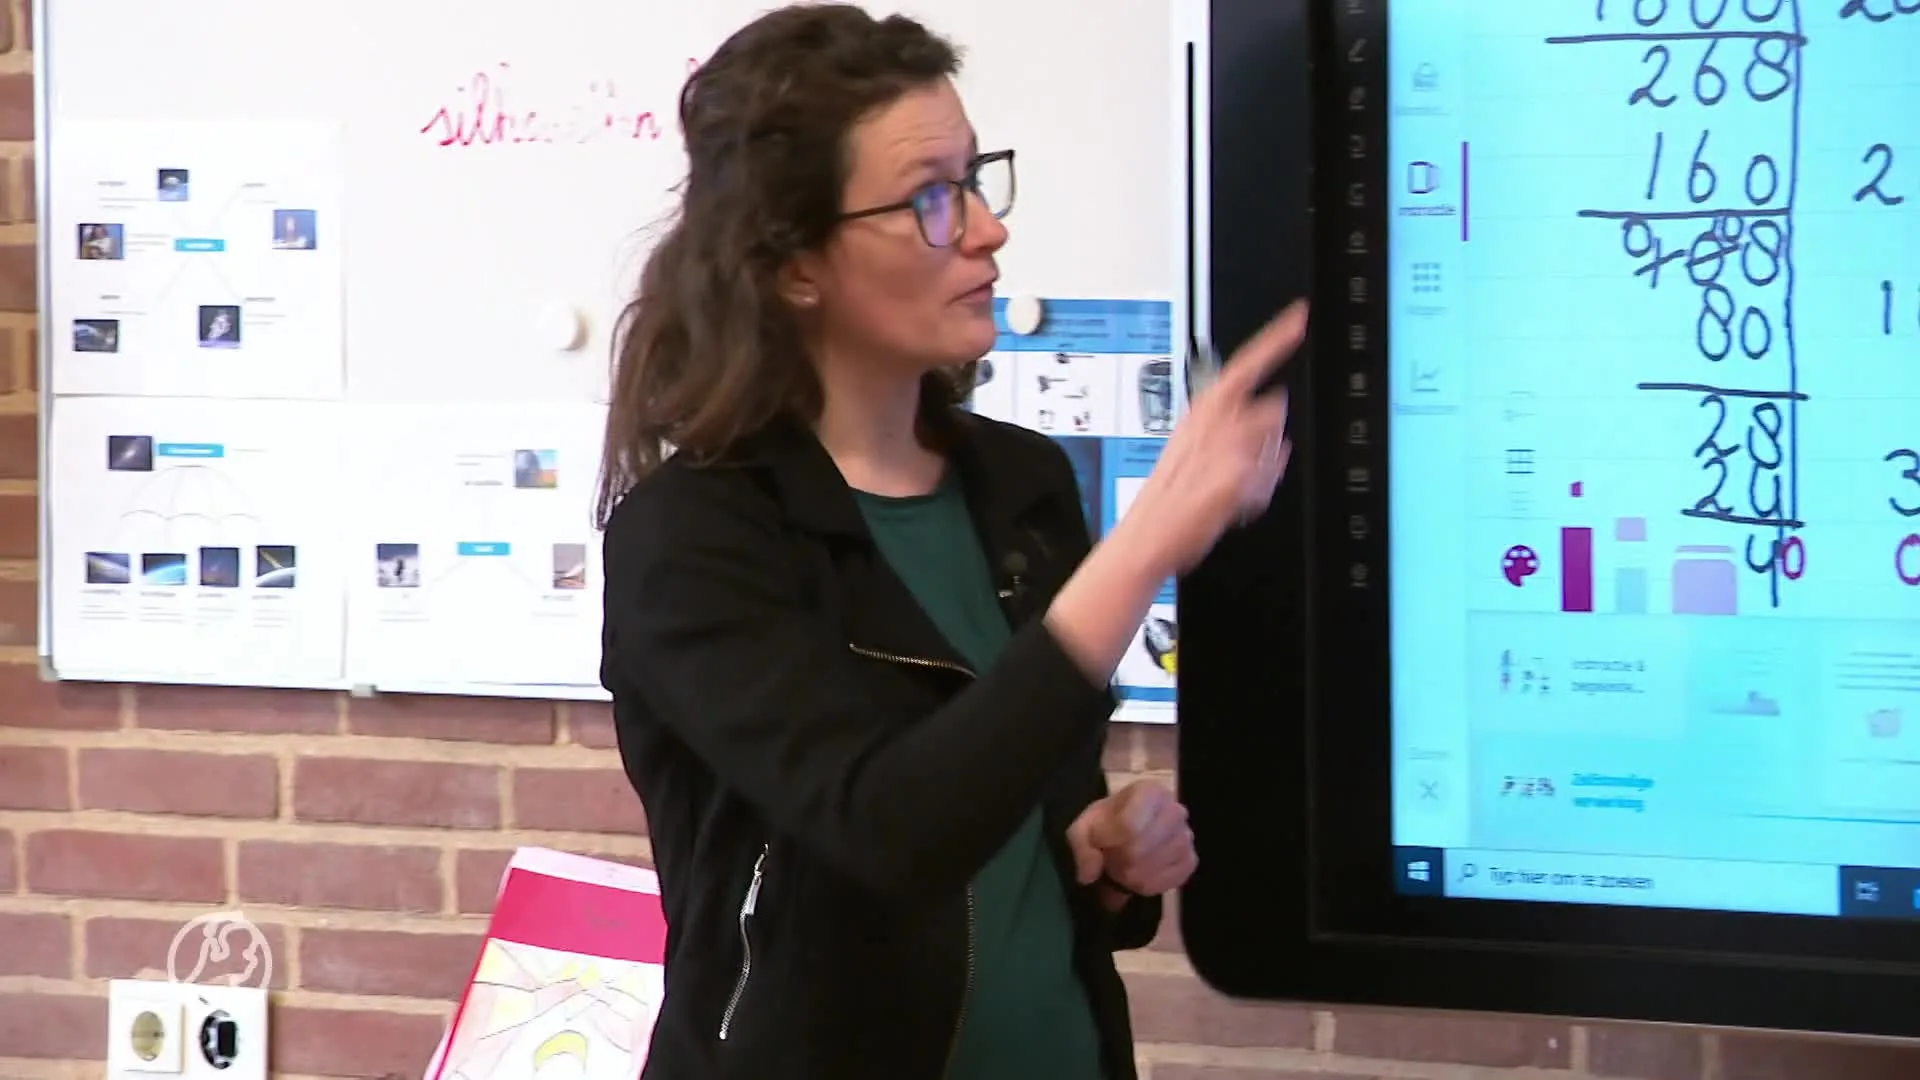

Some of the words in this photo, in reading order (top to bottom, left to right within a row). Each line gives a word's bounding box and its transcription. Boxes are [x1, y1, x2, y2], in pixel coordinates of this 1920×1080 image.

[1628, 36, 1792, 107] 268
[1646, 129, 1778, 206] 160
[1697, 284, 1772, 362] 80
[1694, 394, 1783, 470] 28
[1694, 457, 1784, 530] 24
[1883, 448, 1920, 517] 3
[1489, 866, 1515, 886] Typ
[1519, 869, 1548, 885] hier
[1552, 873, 1577, 886] om
